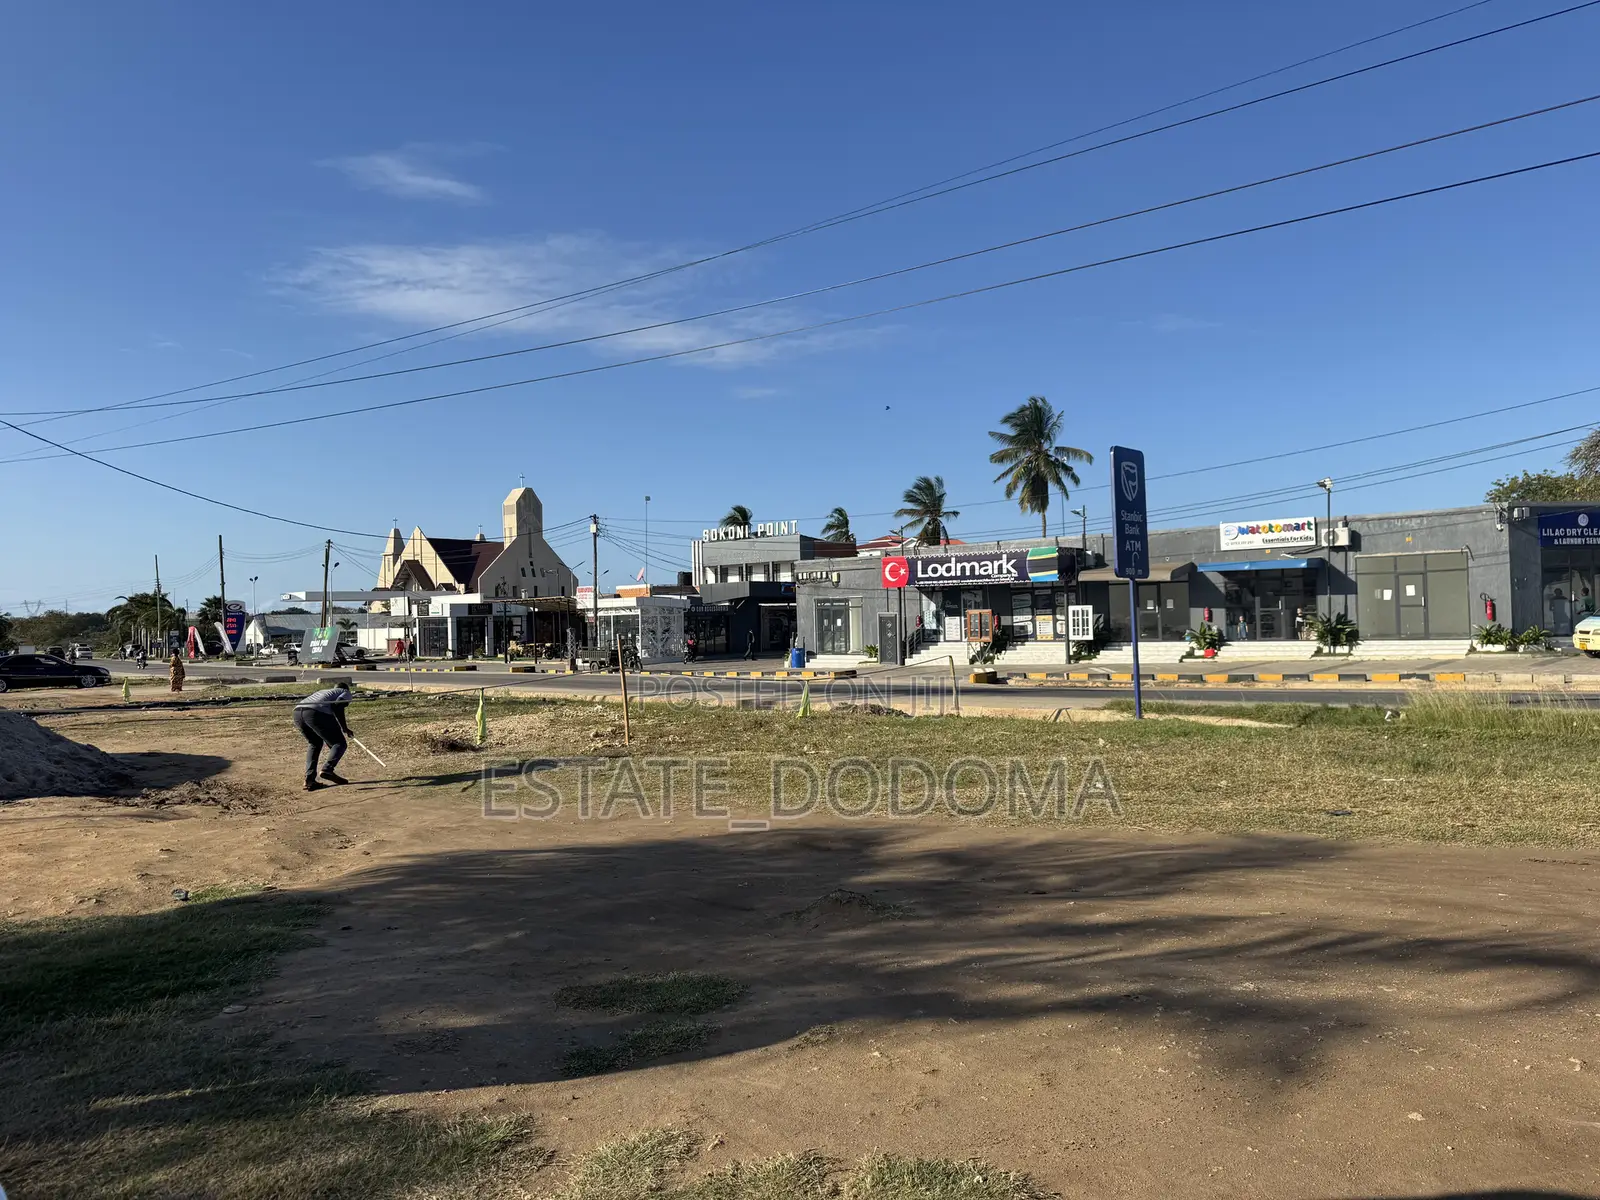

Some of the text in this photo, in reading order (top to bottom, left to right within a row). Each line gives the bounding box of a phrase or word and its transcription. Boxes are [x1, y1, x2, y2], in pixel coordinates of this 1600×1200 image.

[1121, 510, 1143, 522] Stanbic
[703, 520, 798, 542] SOKONI POINT
[1125, 523, 1140, 535] Bank
[1542, 528, 1600, 536] LILAC DRY CLE
[1125, 540, 1141, 552] ATM
[917, 554, 1018, 578] Lodmark
